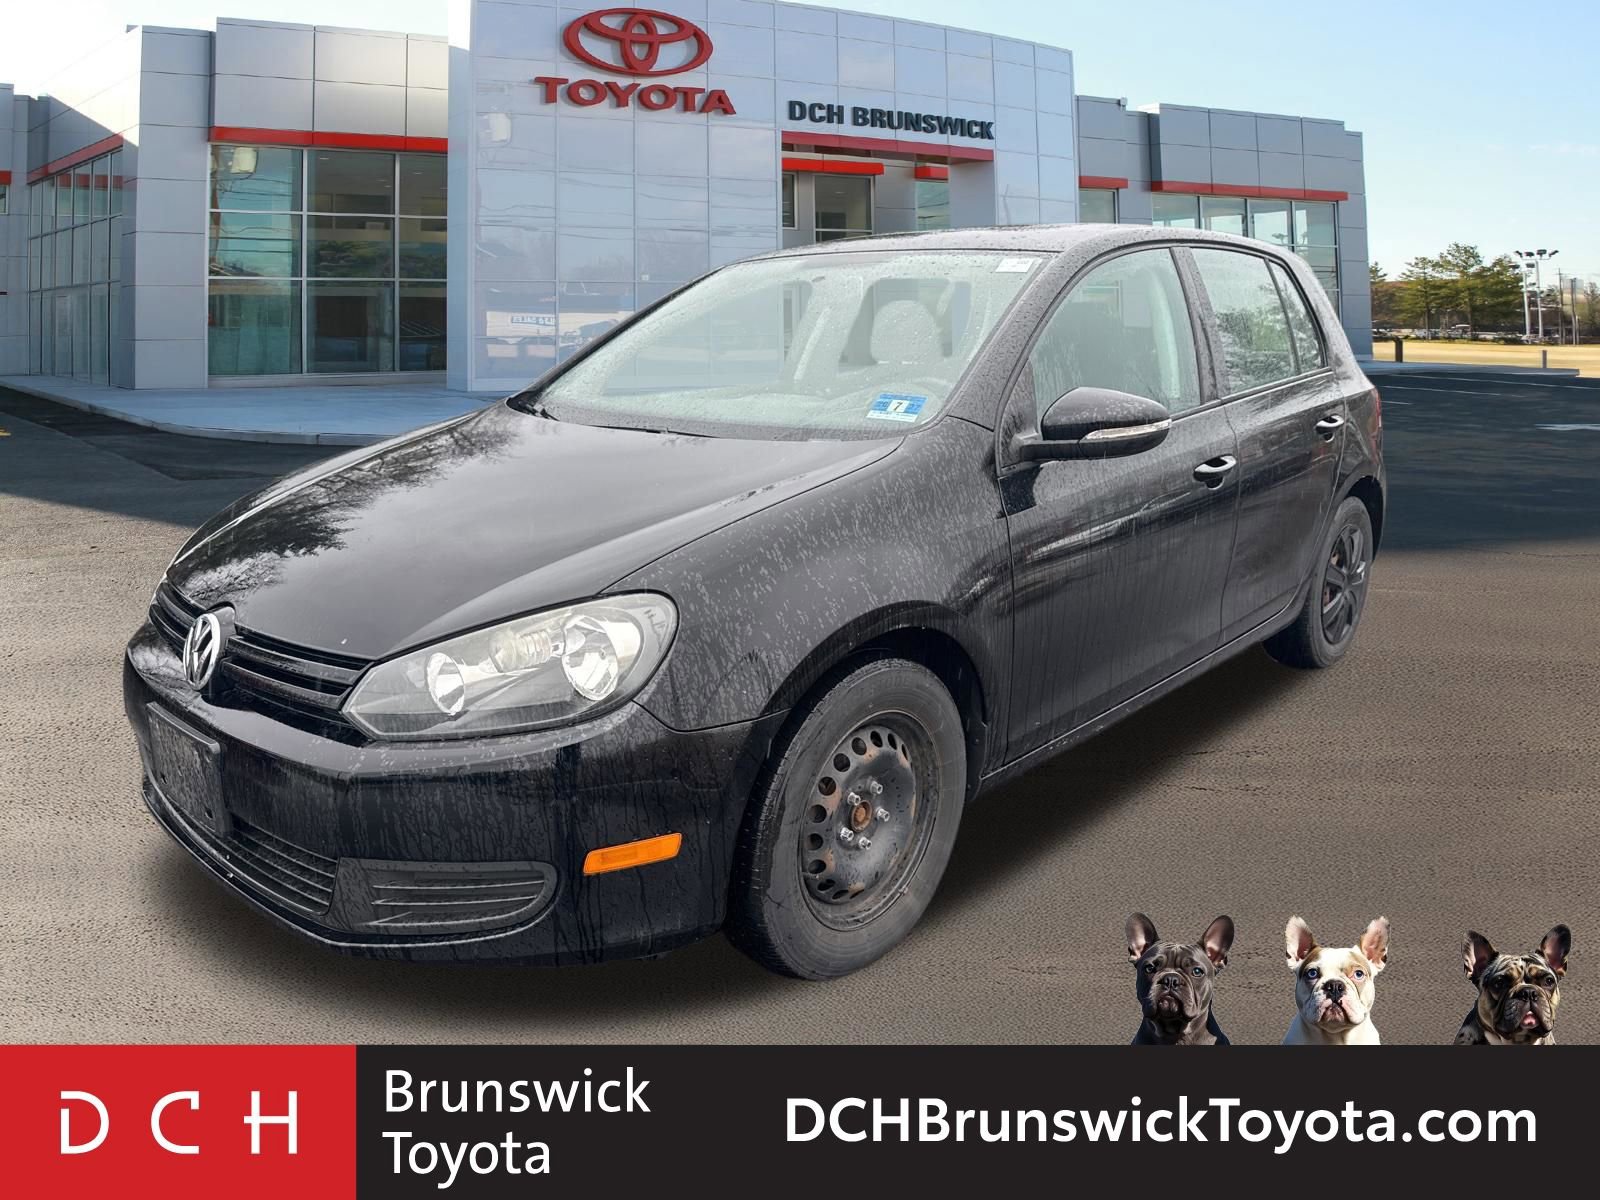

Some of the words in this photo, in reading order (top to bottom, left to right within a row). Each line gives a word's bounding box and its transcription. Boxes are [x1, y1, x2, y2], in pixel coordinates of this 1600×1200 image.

[535, 76, 736, 115] TOYOTA
[788, 100, 845, 125] DCH
[852, 107, 995, 140] BRUNSWICK
